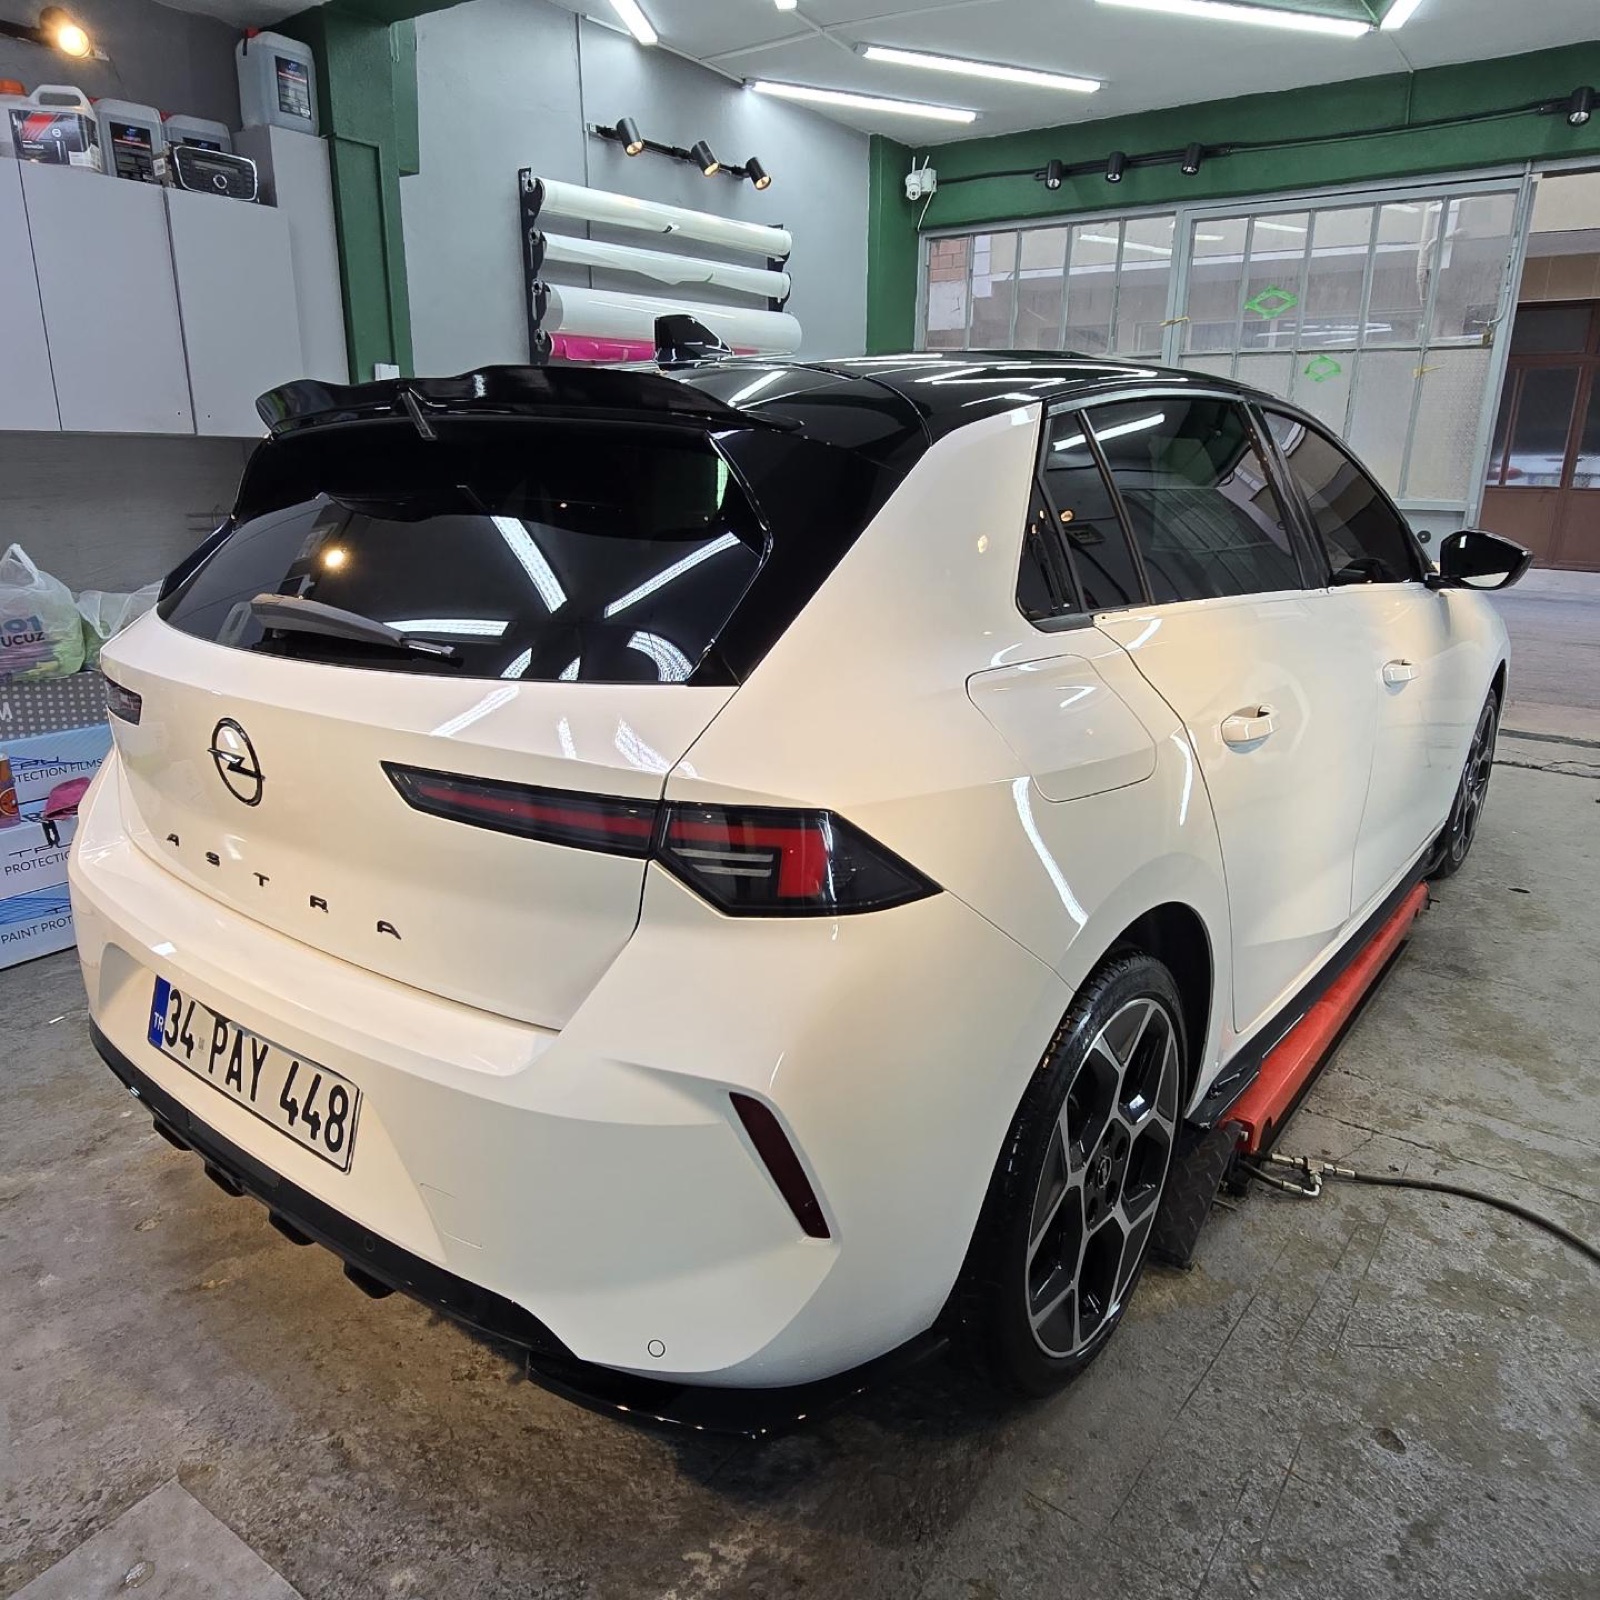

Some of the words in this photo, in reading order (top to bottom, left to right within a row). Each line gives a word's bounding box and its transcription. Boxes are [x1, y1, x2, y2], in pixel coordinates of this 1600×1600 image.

[0, 615, 42, 635] 01
[1, 631, 45, 648] UCUZ
[15, 766, 68, 782] TECTION
[70, 758, 103, 772] FILMS
[4, 850, 70, 876] PROTECTIO
[166, 833, 402, 941] ASTRA
[1, 925, 39, 944] PAINT
[41, 915, 73, 932] PROT
[153, 1012, 165, 1033] TR
[164, 988, 196, 1060] 34
[208, 1017, 269, 1102] PAY
[279, 1060, 349, 1153] 448
